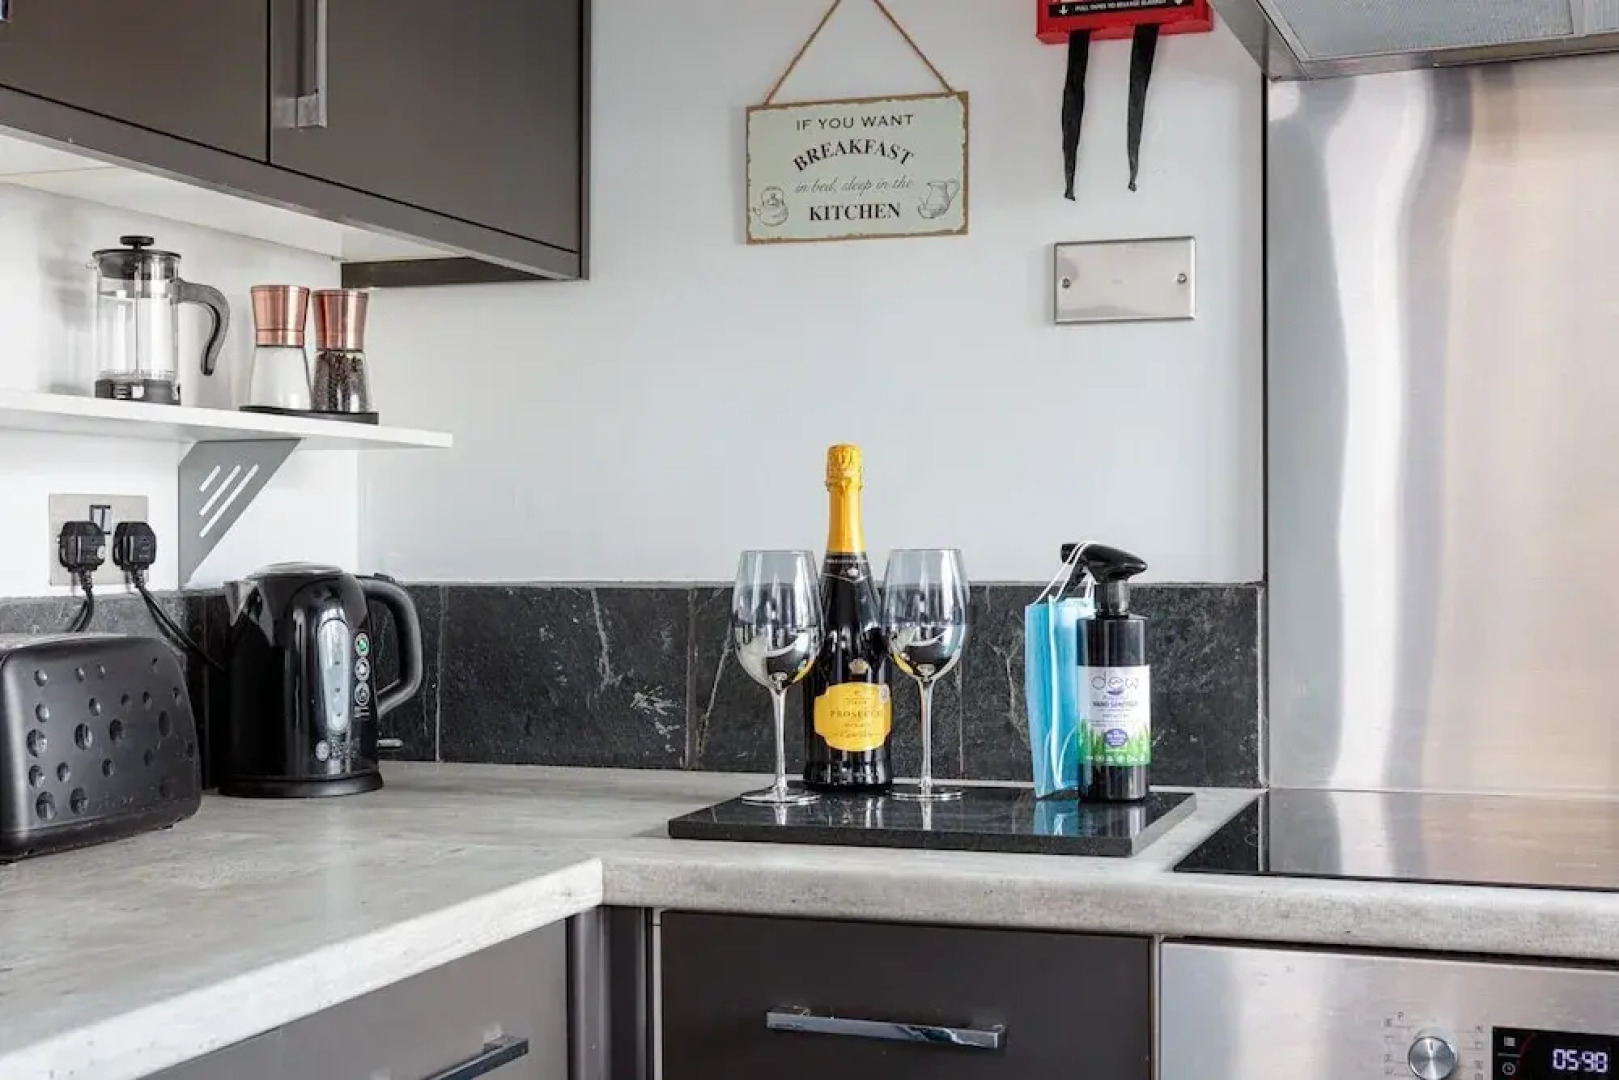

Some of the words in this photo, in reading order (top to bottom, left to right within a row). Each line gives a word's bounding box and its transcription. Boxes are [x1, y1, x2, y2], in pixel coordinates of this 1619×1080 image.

[796, 119, 812, 131] IF
[818, 117, 854, 130] YOU
[861, 114, 914, 128] WANT
[793, 138, 914, 172] BREAKFAST
[841, 175, 872, 197] sleep
[891, 174, 911, 189] the
[809, 203, 900, 221] KITCHEN
